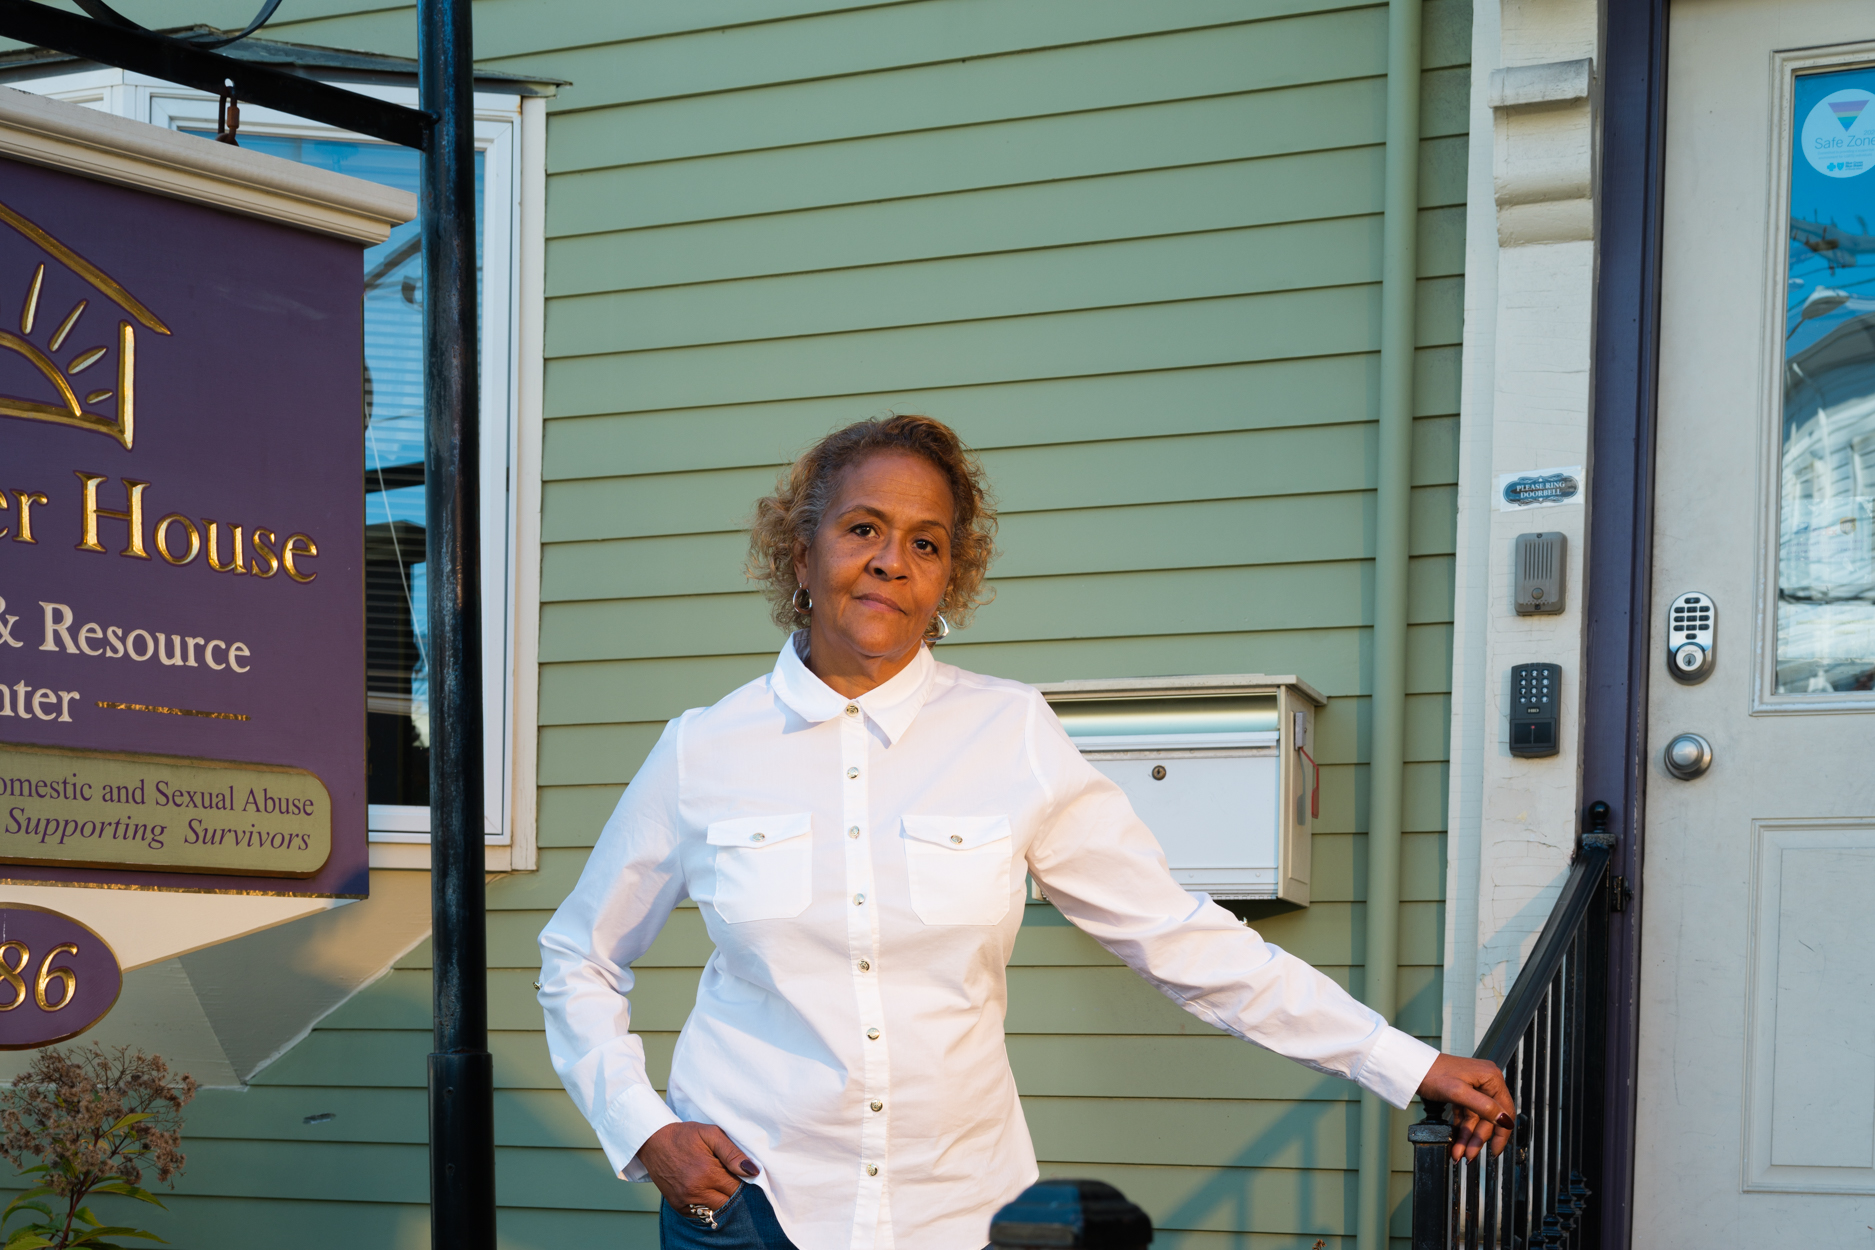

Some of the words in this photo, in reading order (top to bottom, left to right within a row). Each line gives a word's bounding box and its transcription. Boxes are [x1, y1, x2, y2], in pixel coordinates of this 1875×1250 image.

[1815, 136, 1844, 149] Safe
[1516, 483, 1545, 492] PLEASE
[1546, 481, 1566, 489] RING
[1520, 488, 1561, 498] DOORBELL
[0, 488, 48, 544] r
[74, 471, 318, 584] House
[39, 601, 251, 673] Resource
[102, 779, 147, 806] and
[155, 780, 235, 812] Sexual
[242, 787, 314, 816] Abuse
[5, 807, 167, 850] Supporting
[184, 818, 311, 851] Survivors
